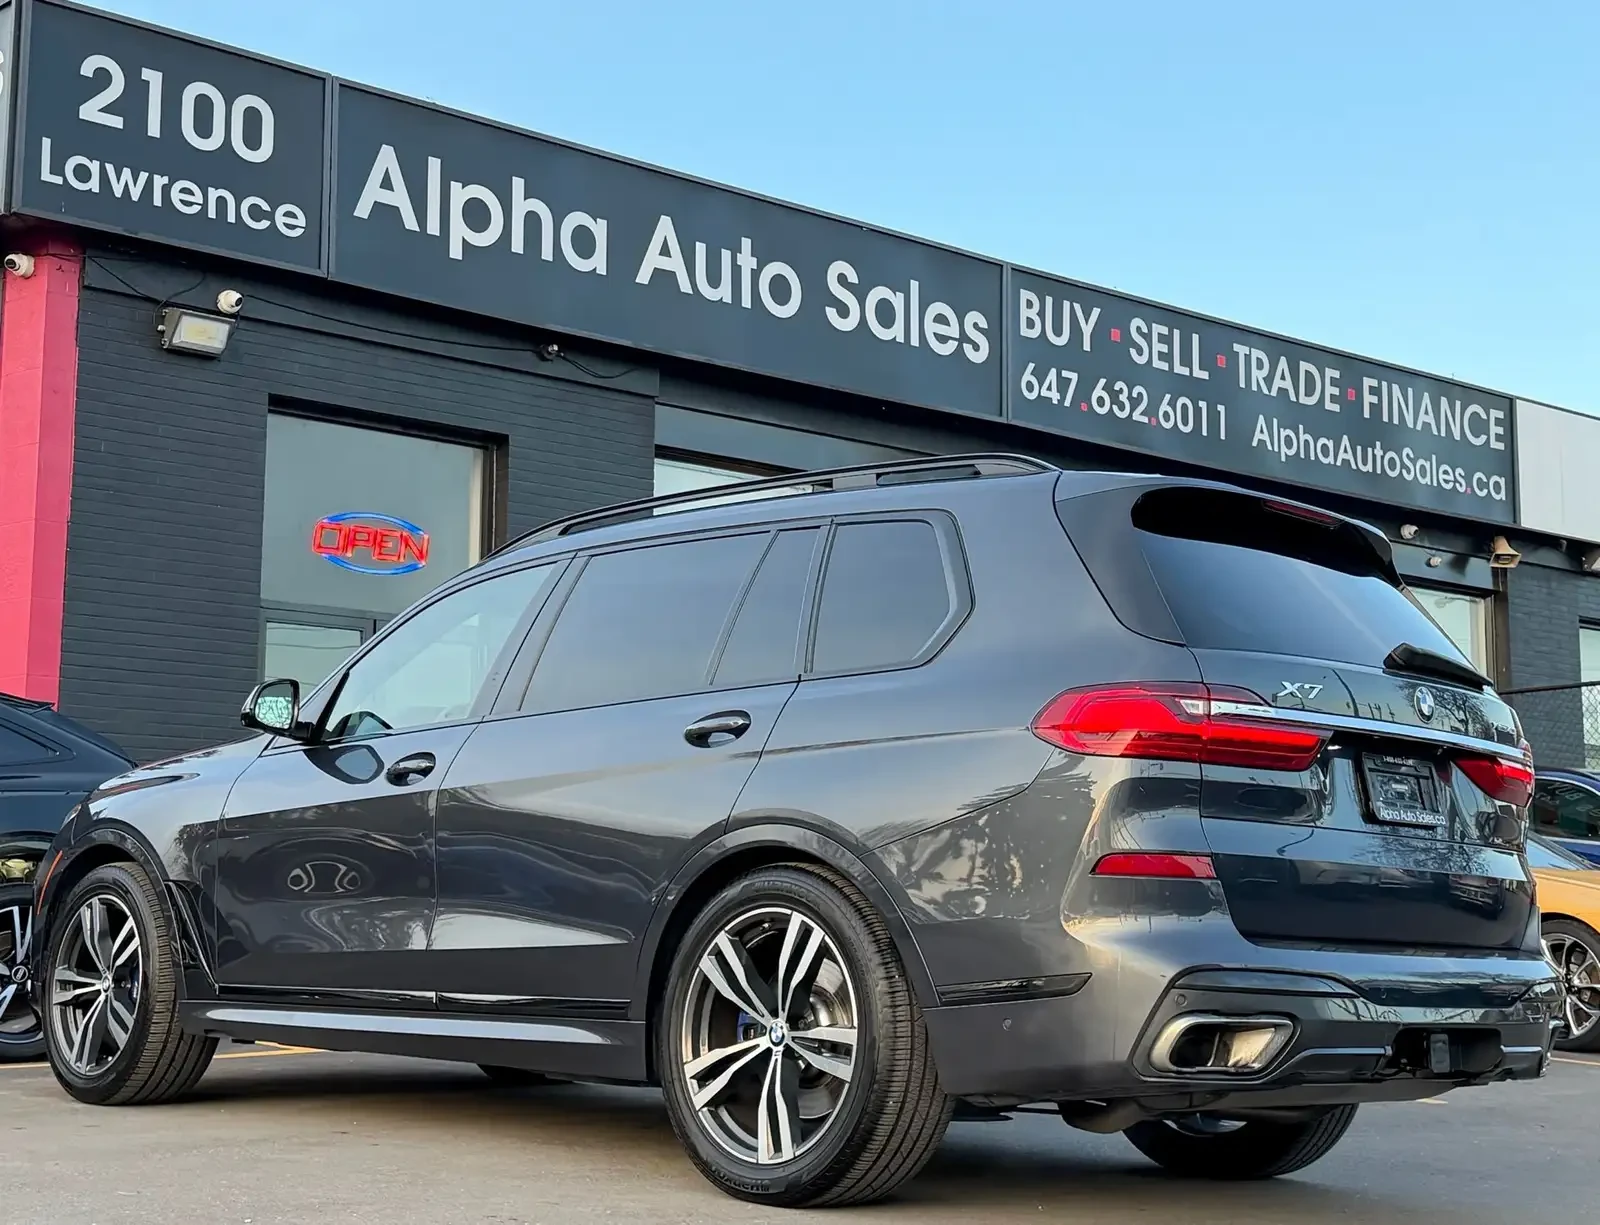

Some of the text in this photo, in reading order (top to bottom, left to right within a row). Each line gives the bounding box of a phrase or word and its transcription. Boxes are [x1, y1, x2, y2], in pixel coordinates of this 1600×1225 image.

[79, 54, 275, 164] 2100
[40, 137, 307, 238] Lawrence
[353, 144, 990, 364] Alpha Auto Sales
[1019, 288, 1506, 450] BUY SELL TRADE FINANCE
[1020, 362, 1507, 501] 647.632.6011 AlphaAutoSales.ca
[312, 519, 430, 566] OPEN
[1276, 680, 1323, 699] X7
